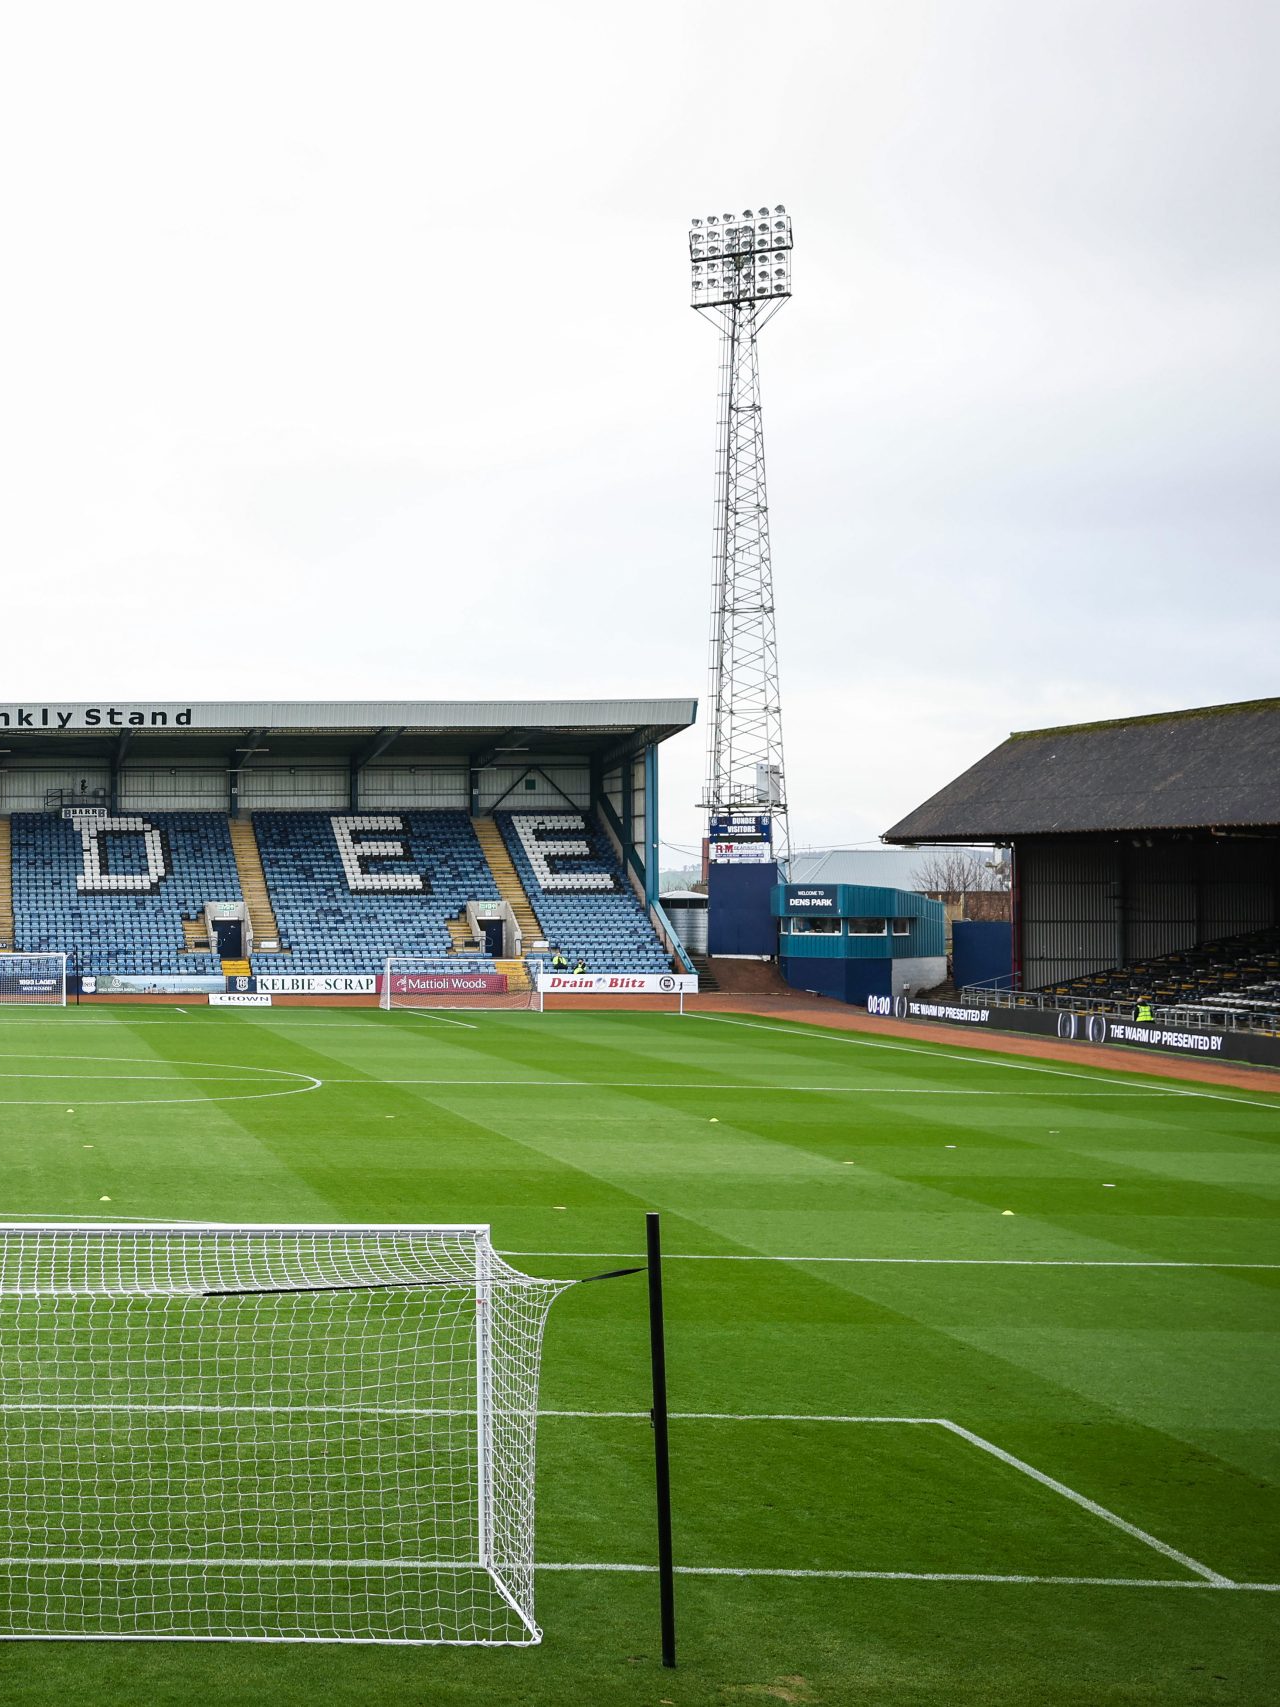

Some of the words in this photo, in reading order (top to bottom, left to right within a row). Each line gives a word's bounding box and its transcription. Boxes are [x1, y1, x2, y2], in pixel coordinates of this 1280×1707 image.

[85, 708, 193, 726] Stand
[732, 817, 756, 825] DUNDEE
[727, 825, 756, 833] VISITORS
[789, 898, 810, 906] DENS
[811, 898, 833, 906] PARK
[260, 978, 315, 990] KELBIE
[324, 978, 374, 990] SCRAP
[408, 978, 449, 989] Mattioli
[451, 978, 487, 989] Woods
[550, 977, 594, 988] Drain
[608, 977, 645, 988] Blitz
[909, 1003, 920, 1015] THE
[920, 1004, 938, 1017] WARM
[938, 1006, 946, 1018] UP
[945, 1007, 981, 1021] PRESENTED
[980, 1010, 990, 1022] BY
[1110, 1025, 1124, 1038] THE
[1125, 1026, 1149, 1042] WARM
[1149, 1030, 1161, 1044] UP
[1161, 1032, 1210, 1050] PRESENTED
[1210, 1036, 1223, 1051] BY
